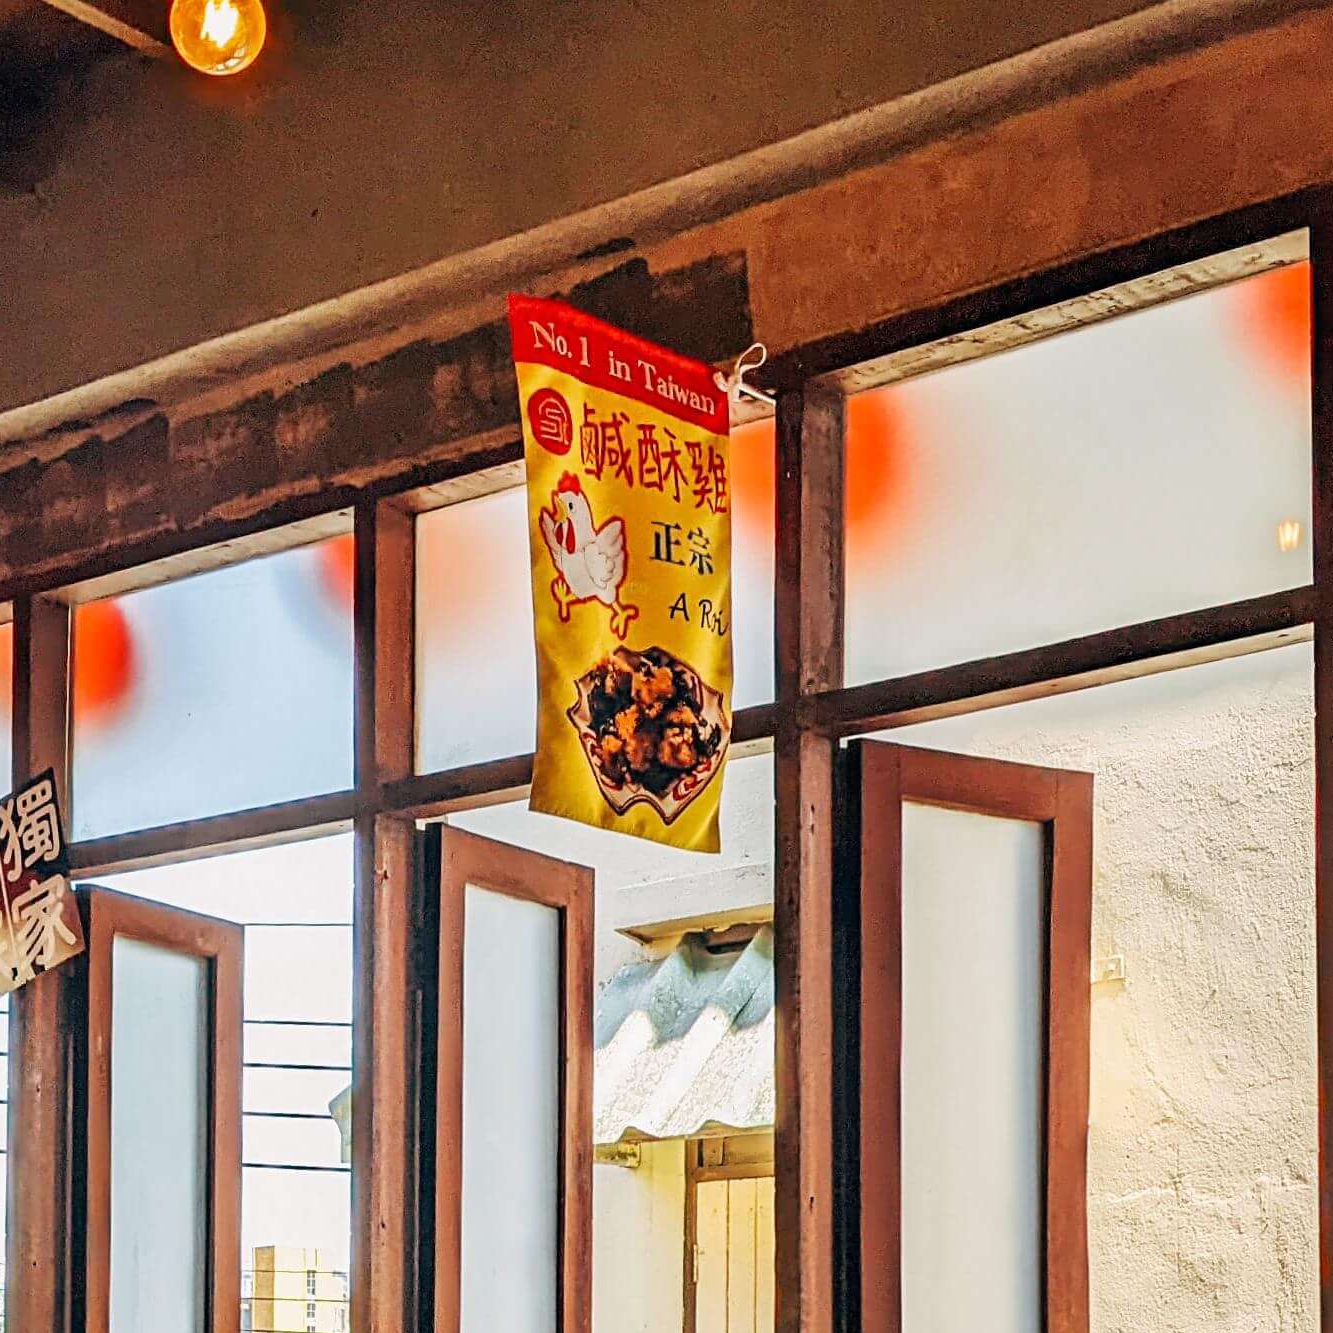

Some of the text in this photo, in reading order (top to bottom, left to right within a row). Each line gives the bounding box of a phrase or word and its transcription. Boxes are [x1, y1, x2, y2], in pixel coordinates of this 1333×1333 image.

[608, 350, 632, 382] in
[637, 359, 715, 415] Taiwan
[648, 521, 714, 575] 正宗
[668, 592, 690, 622] A
